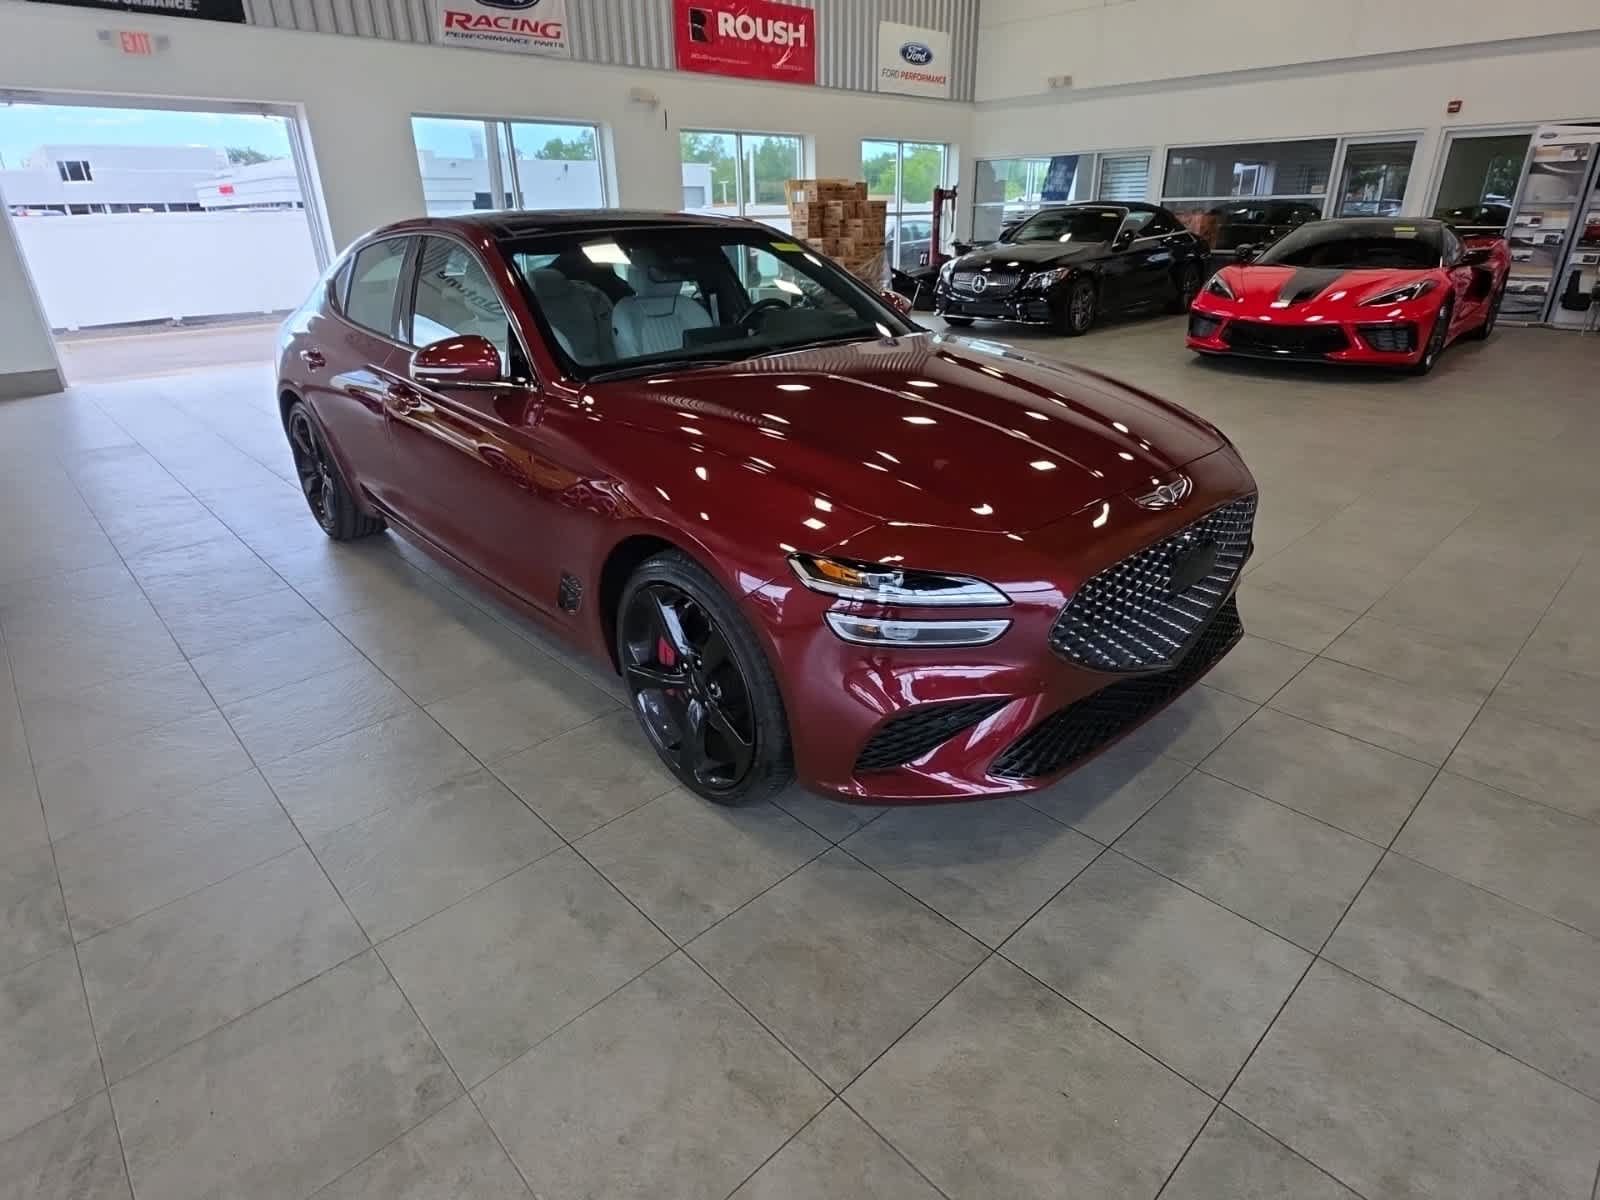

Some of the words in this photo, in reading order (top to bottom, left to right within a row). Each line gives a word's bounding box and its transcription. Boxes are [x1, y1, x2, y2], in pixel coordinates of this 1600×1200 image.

[99, 0, 198, 11] RMANCE.
[444, 10, 562, 39] RACING
[717, 12, 806, 47] ROUSH
[120, 31, 152, 55] EXIT
[445, 31, 530, 45] PERFORMANCE
[533, 40, 564, 48] PARTS
[906, 46, 927, 62] Ford
[881, 68, 899, 79] FORD
[900, 71, 946, 85] PERFORMANCE
